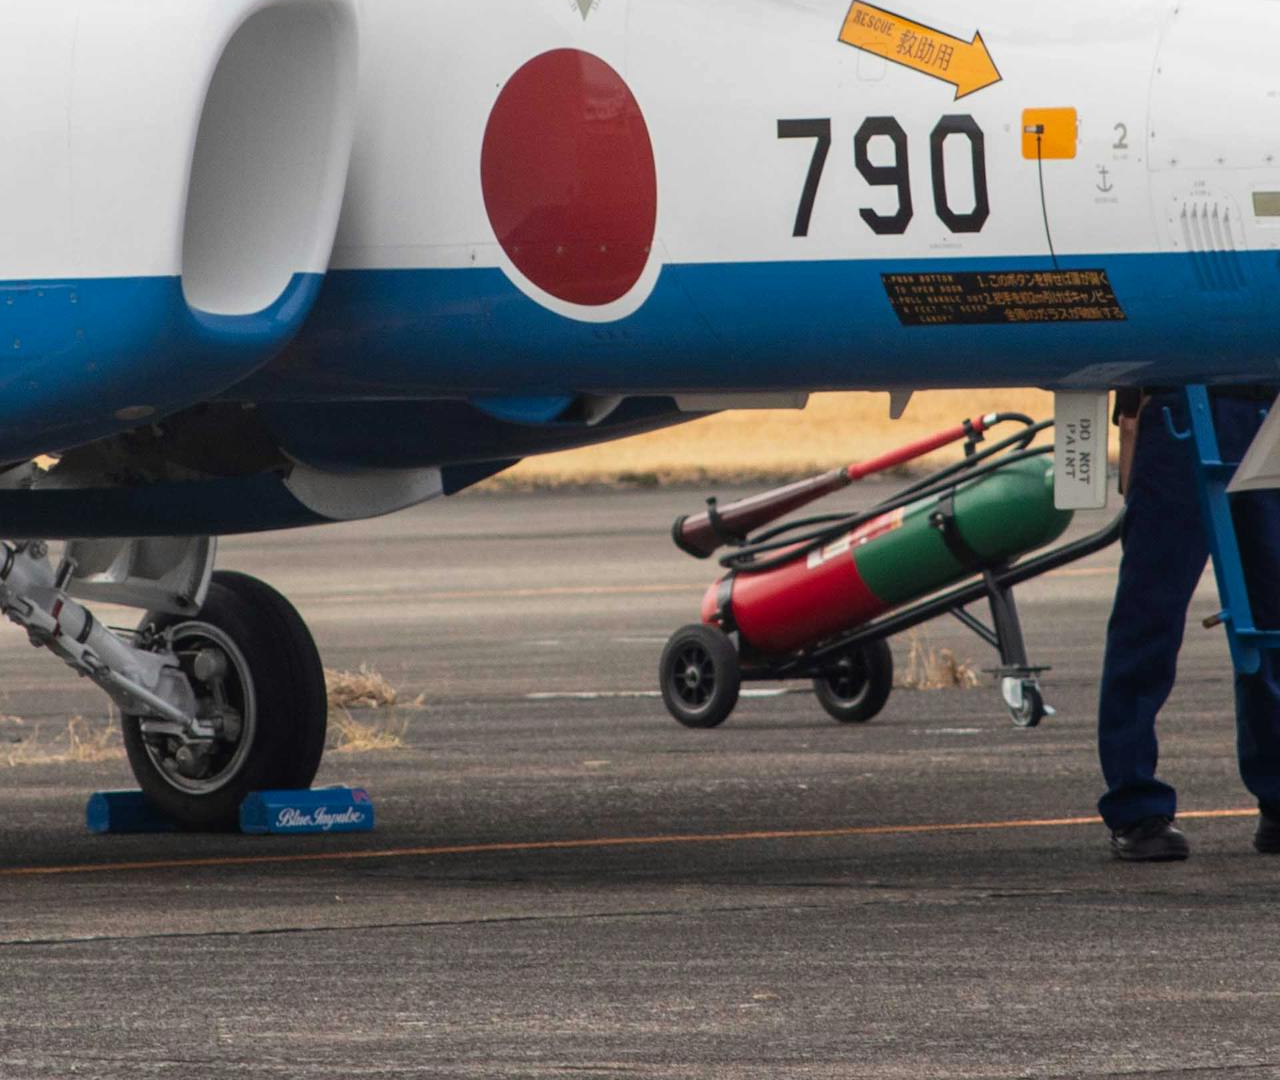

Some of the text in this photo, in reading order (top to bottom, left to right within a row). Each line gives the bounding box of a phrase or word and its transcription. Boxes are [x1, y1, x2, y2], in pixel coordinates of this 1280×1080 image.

[853, 8, 896, 37] RESCUE
[896, 28, 954, 72] 救助用
[1112, 122, 1129, 150] 2
[776, 114, 991, 237] 790
[1065, 423, 1076, 479] PAINT
[1079, 418, 1091, 485] DO NOT
[275, 807, 365, 831] Blue Impulse
